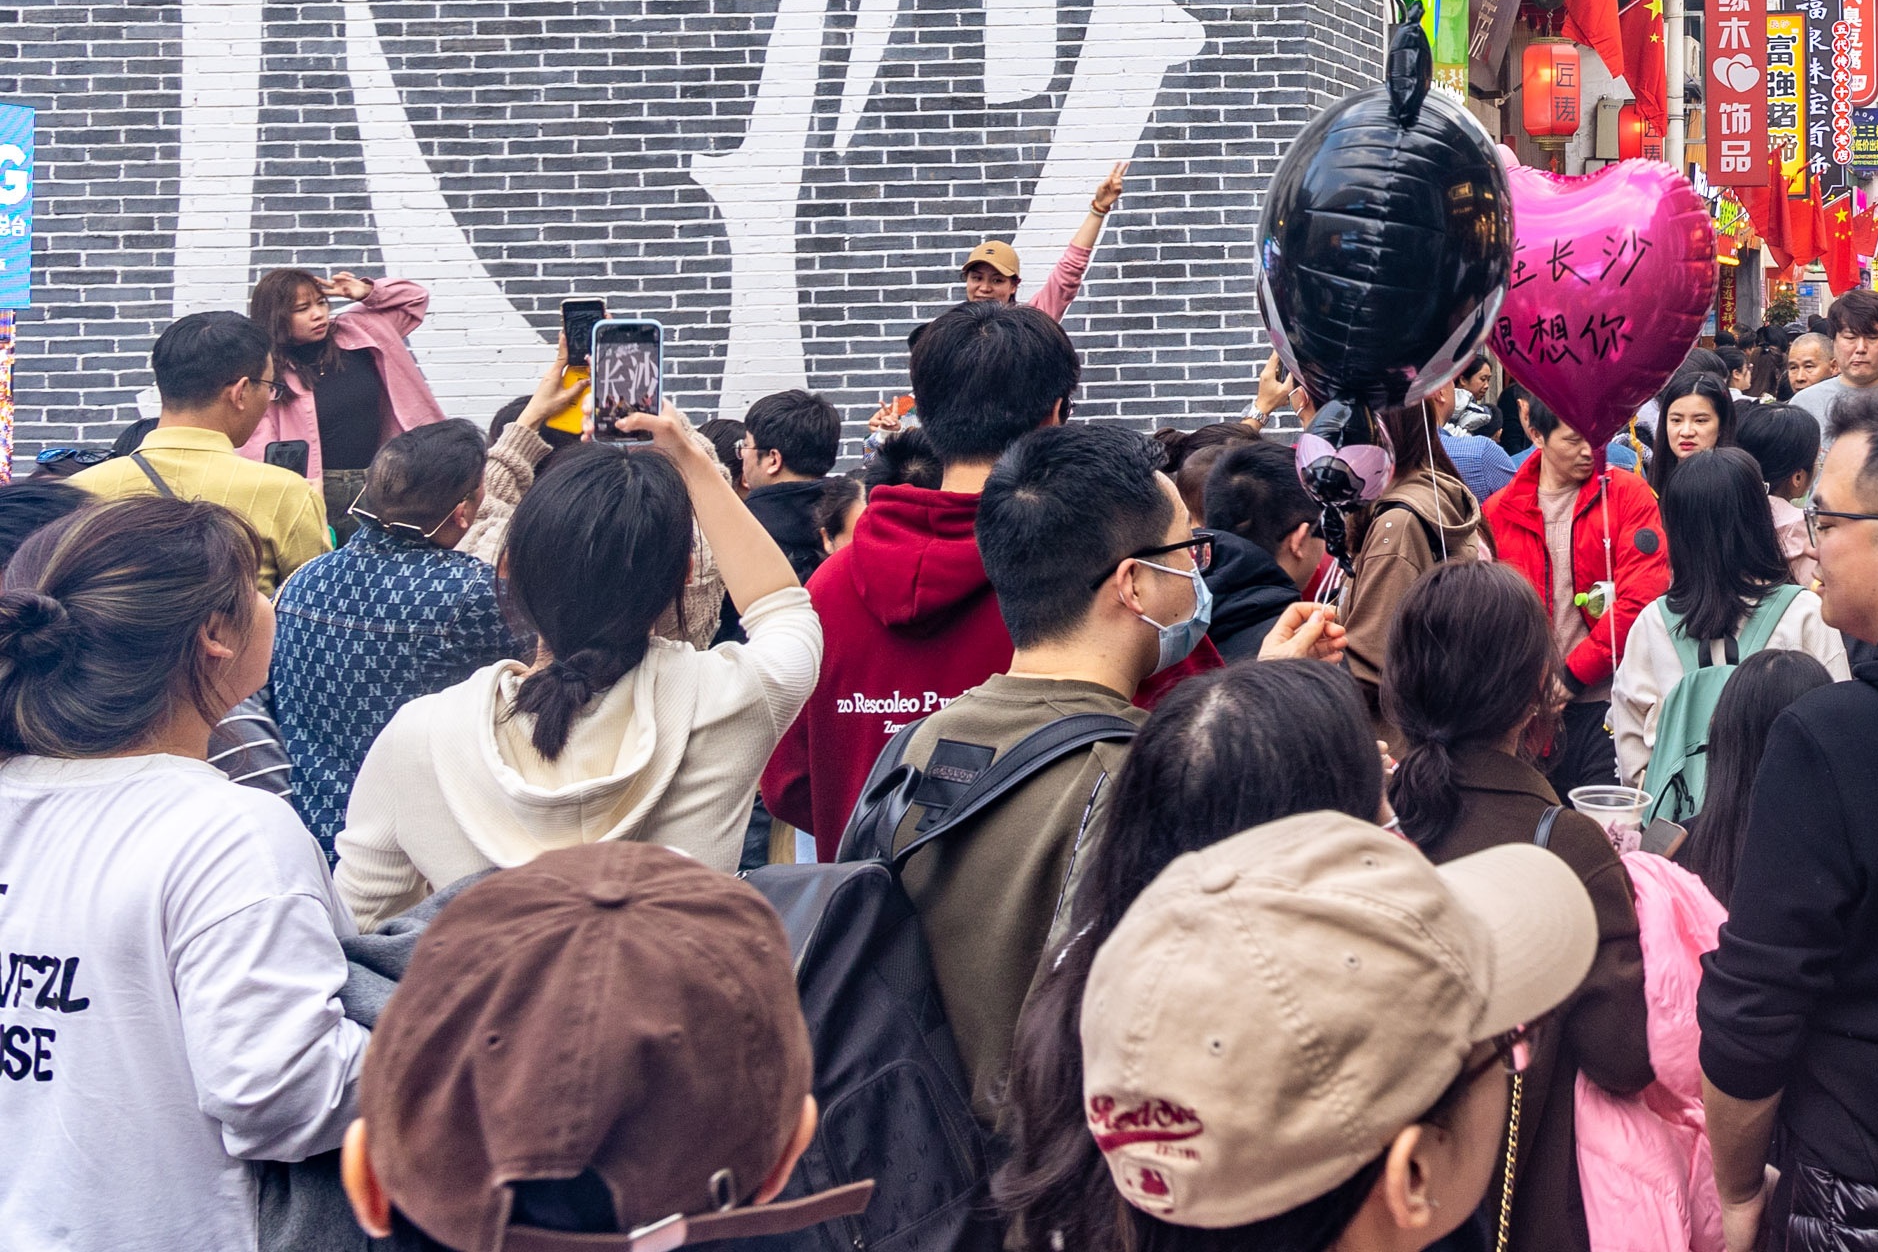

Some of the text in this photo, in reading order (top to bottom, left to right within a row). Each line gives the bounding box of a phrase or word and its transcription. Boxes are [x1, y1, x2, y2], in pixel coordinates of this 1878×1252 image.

[1835, 24, 1850, 162] 五代传承十五年老店
[1719, 102, 1752, 174] 饰品
[0, 1023, 57, 1082] SE
